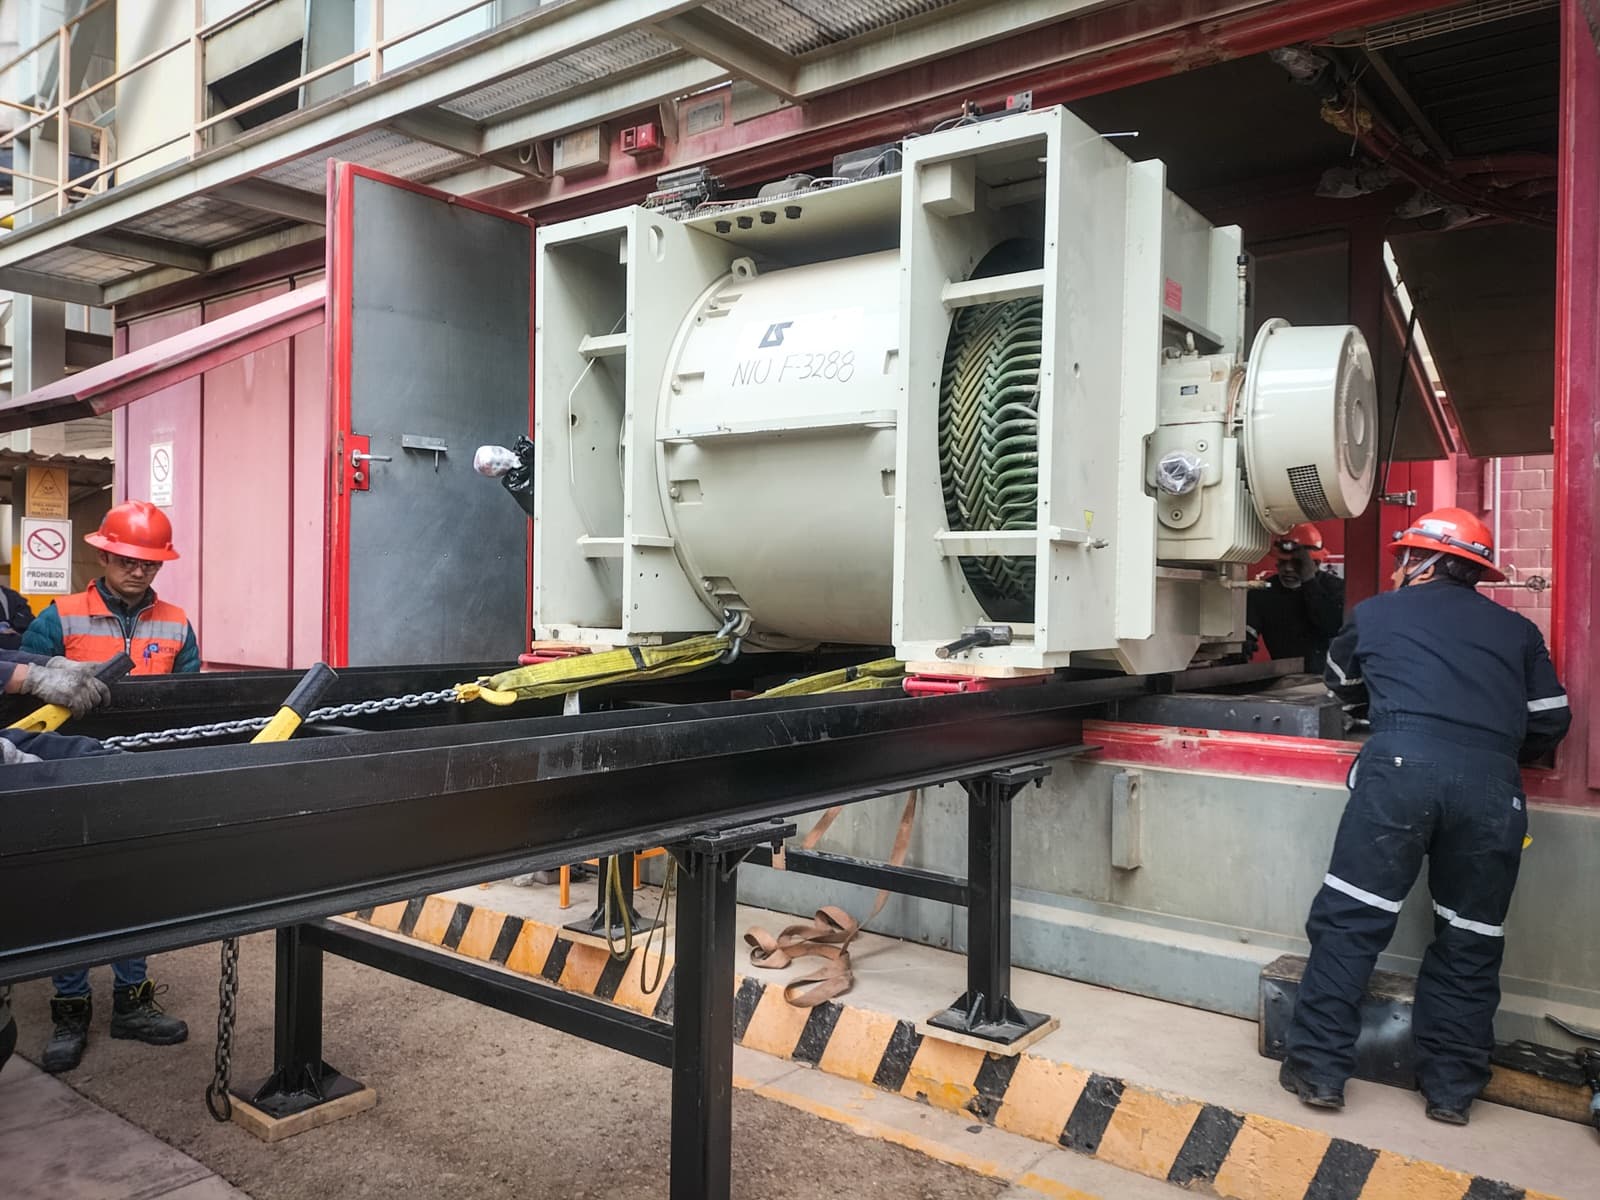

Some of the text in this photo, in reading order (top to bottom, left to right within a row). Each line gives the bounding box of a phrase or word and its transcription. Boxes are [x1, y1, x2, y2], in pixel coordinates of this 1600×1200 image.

[778, 350, 855, 383] F-3288
[26, 570, 65, 579] PROHIBIDO
[33, 580, 58, 588] FUMAR
